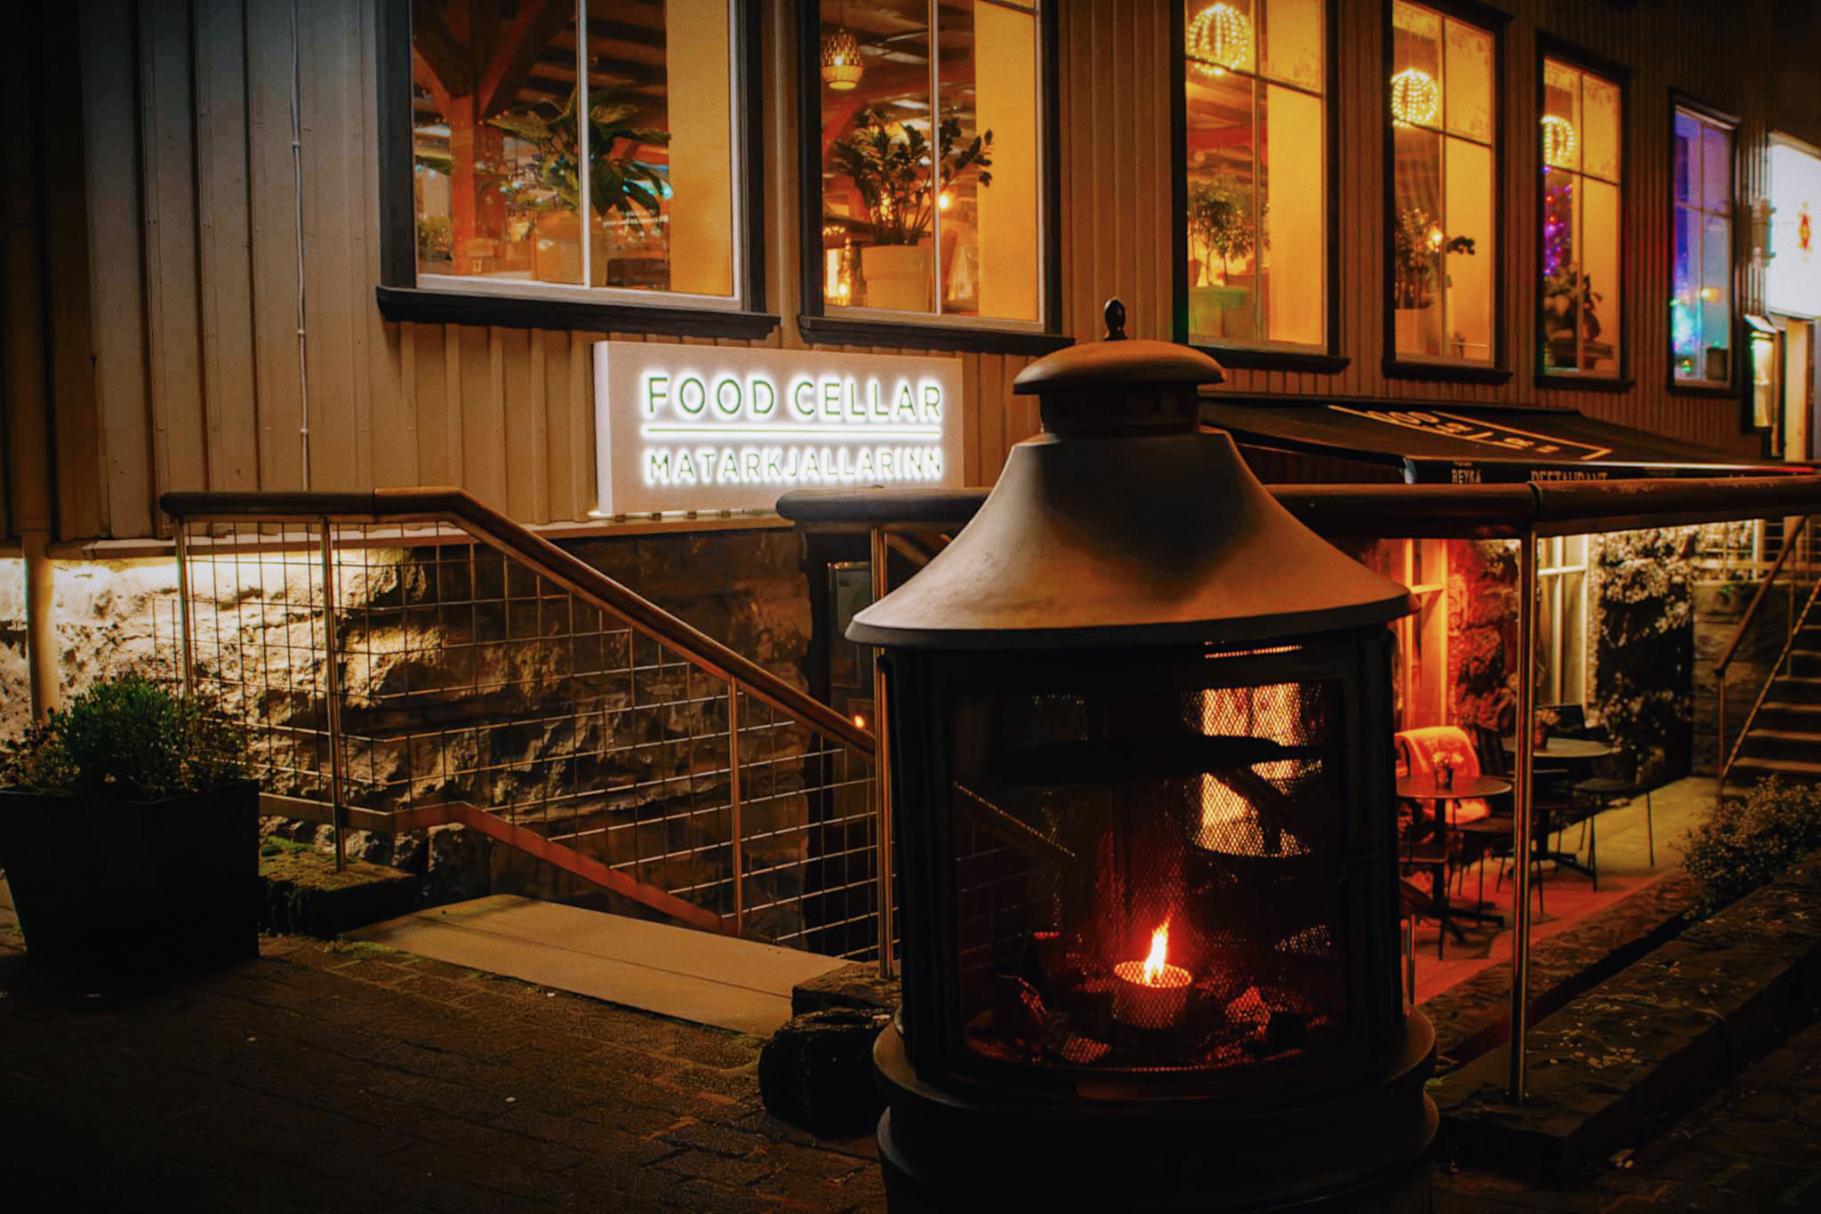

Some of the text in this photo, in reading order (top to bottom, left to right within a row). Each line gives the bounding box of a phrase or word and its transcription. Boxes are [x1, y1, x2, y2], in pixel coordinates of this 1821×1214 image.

[647, 376, 942, 417] FOOD CELLAR
[649, 451, 942, 482] MATARKJALLARINN
